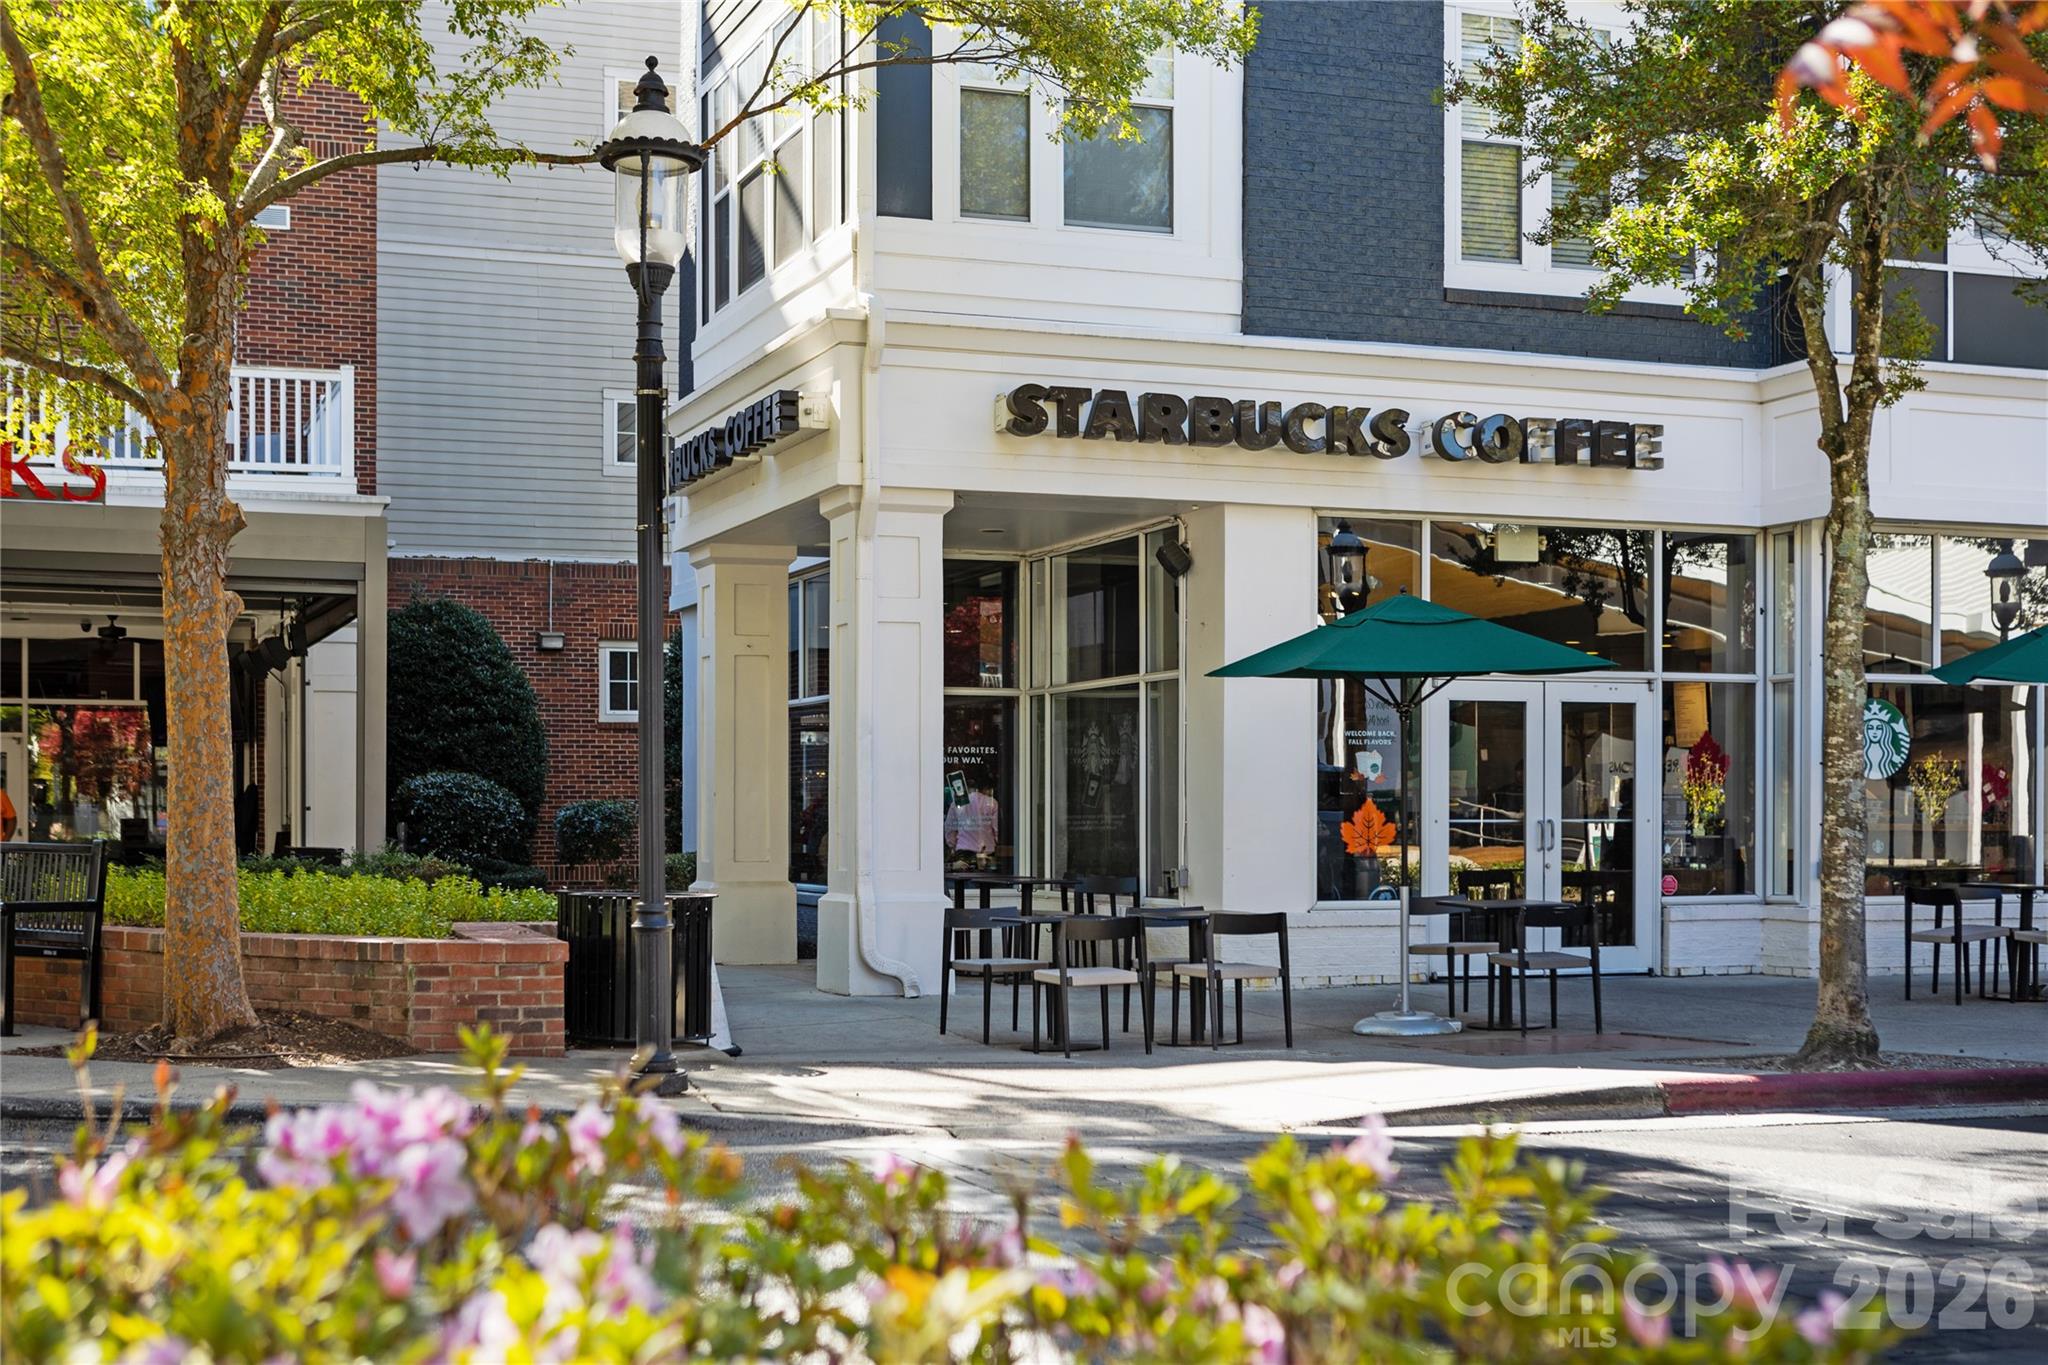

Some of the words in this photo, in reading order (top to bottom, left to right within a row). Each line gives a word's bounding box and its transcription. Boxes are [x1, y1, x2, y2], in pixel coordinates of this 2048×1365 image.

[724, 390, 799, 458] COFFEE
[1005, 383, 1411, 460] STARBUCKS
[1432, 411, 1665, 471] COFFEE
[1343, 730, 1377, 738] WELCOME
[1348, 738, 1363, 746] FALL
[1363, 738, 1392, 746] FLAVORS
[947, 746, 998, 754] FAVORITES.
[961, 756, 984, 764] WAY.
